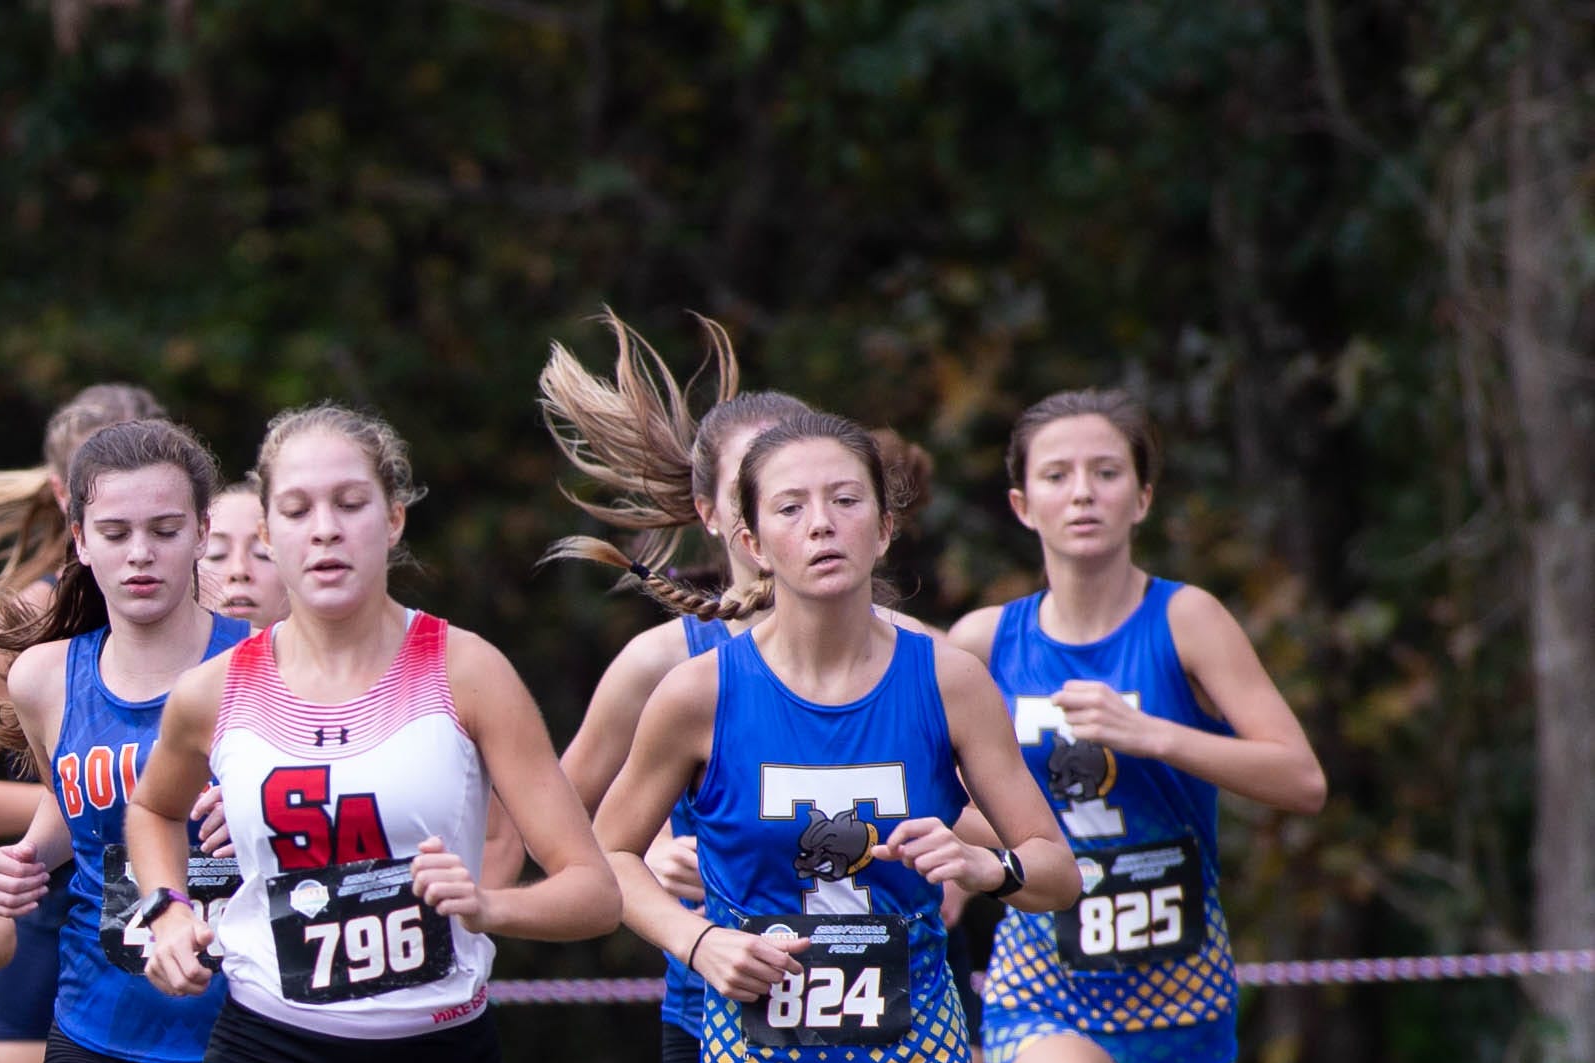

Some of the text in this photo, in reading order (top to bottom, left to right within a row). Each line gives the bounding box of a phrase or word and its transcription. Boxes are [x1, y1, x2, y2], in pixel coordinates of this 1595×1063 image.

[261, 765, 393, 873] SA
[760, 762, 909, 914] T
[305, 904, 425, 989] 796
[1080, 885, 1182, 955] 825
[767, 967, 885, 1028] 824
